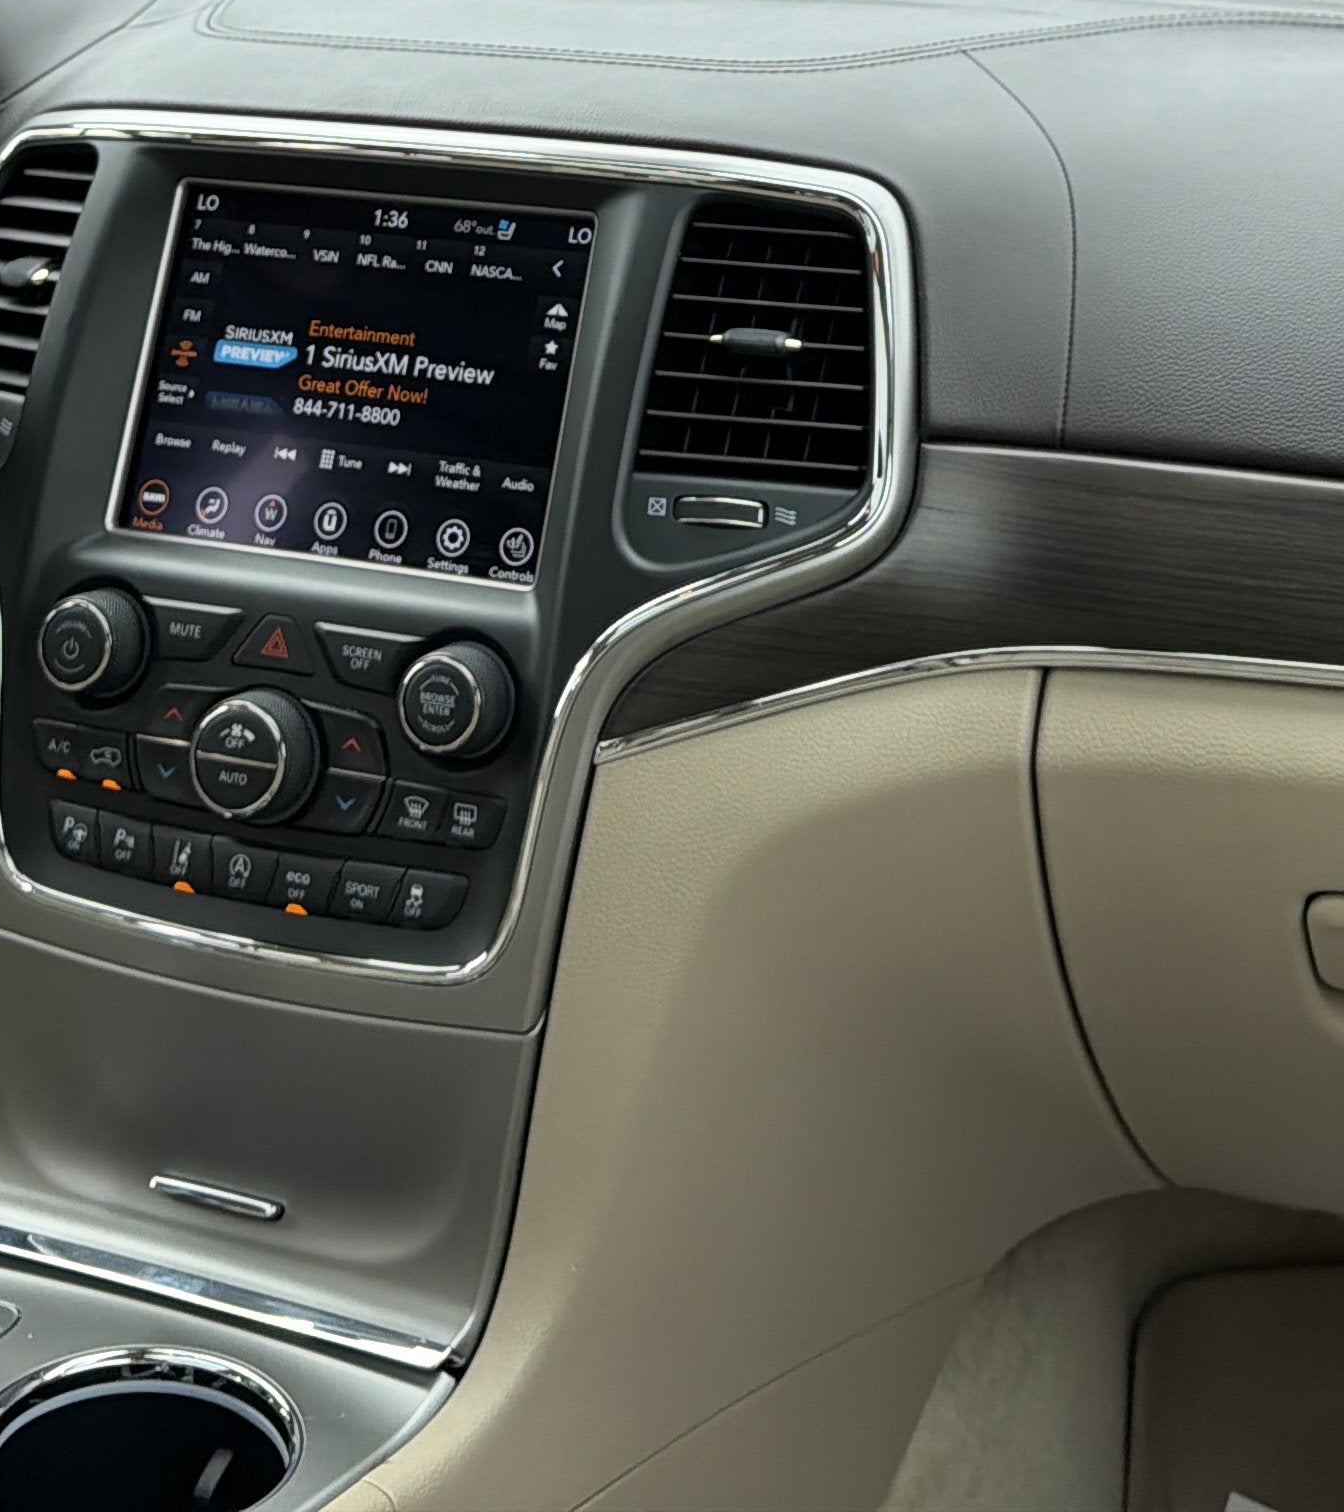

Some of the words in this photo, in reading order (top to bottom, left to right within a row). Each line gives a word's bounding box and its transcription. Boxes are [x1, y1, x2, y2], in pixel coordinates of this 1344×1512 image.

[196, 193, 220, 211] LO
[373, 209, 408, 229] 1:36
[567, 226, 592, 244] LO
[194, 219, 202, 230] 7
[247, 224, 256, 235] 8
[303, 229, 311, 239] 9
[359, 235, 371, 246] 10
[416, 240, 427, 250] 11
[473, 245, 486, 256] 12
[191, 237, 212, 251] The
[356, 253, 380, 267] NFL
[424, 260, 453, 274] CNN
[189, 271, 210, 284] AM
[182, 308, 202, 322] FM
[543, 318, 567, 332] Map
[224, 324, 294, 345] SIRIUSXM
[308, 319, 416, 347] Entertainment
[221, 345, 286, 363] PREVIEW
[305, 344, 316, 365] 1
[321, 346, 409, 376] SiriusXM
[412, 355, 495, 385] Preview
[538, 358, 558, 371] Fav
[158, 379, 187, 393] Source
[298, 373, 341, 394] Great
[344, 380, 383, 400] Offer
[387, 384, 429, 405] Now!
[157, 392, 184, 405] Select
[293, 397, 401, 427] 844-711-8800
[155, 433, 192, 448] Browse
[211, 439, 246, 457] Replay
[338, 455, 363, 470] Tune
[438, 459, 471, 476] Traffic
[472, 464, 481, 477] &
[501, 477, 535, 492] Audio
[435, 475, 481, 492] Weather
[132, 516, 164, 531] Media
[187, 524, 225, 540] Climate
[254, 534, 276, 546] Nav
[311, 540, 339, 556] Apps
[368, 548, 403, 565] Phone
[427, 557, 469, 575] Settings
[489, 566, 535, 583] Controls
[169, 621, 202, 639] MUTE
[342, 644, 382, 661] SCREEN
[350, 658, 370, 671] OFF
[419, 691, 456, 705] BROWSE
[422, 704, 450, 716] ENTER
[47, 738, 71, 753] A/C
[225, 737, 245, 749] OFF
[218, 770, 248, 786] AUTO
[397, 816, 428, 831] FRONT
[451, 825, 475, 838] REAR
[114, 849, 132, 861] OFF
[169, 863, 188, 875] OFF
[228, 876, 246, 889] OFF
[285, 871, 311, 885] eco
[287, 888, 306, 900] OFF
[345, 881, 380, 899] SPORT
[350, 897, 364, 910] ON
[404, 905, 422, 918] OFF
